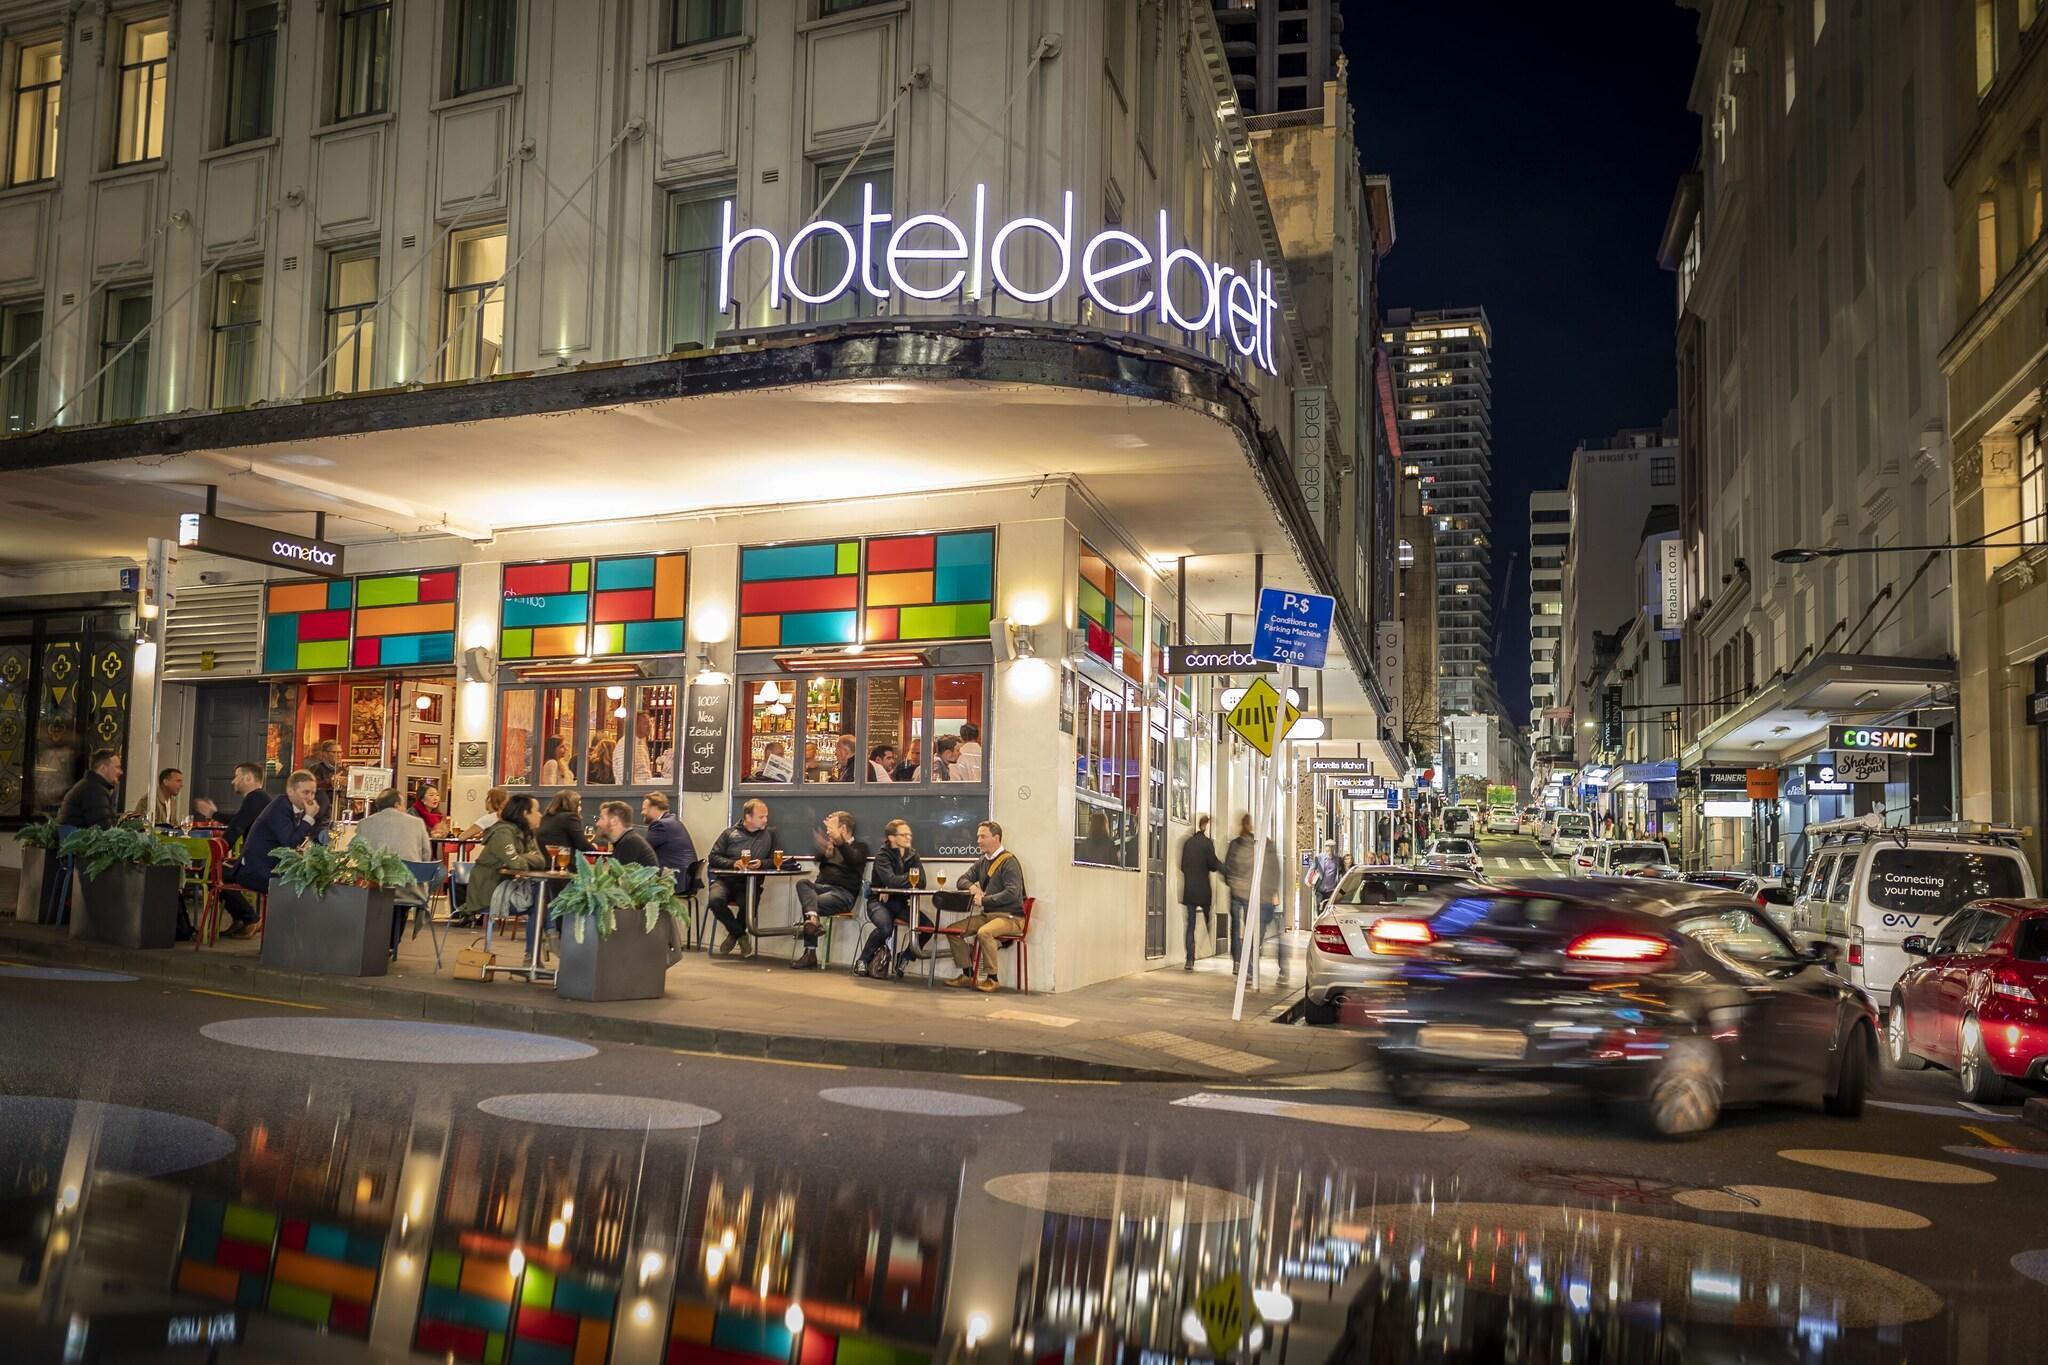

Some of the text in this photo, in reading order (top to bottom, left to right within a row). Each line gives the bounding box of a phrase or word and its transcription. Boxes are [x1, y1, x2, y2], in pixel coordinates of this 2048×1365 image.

[272, 541, 336, 566] cornerbar
[1667, 545, 1678, 619] brabant.co.nz
[1270, 615, 1307, 628] Conditions
[1263, 623, 1322, 639] Parking Machine
[1276, 637, 1307, 648] Times Vary
[1185, 650, 1257, 667] cornerba
[1273, 646, 1305, 661] Zone
[697, 695, 720, 707] 100%
[697, 711, 715, 723] New
[688, 726, 722, 737] Zealand
[1843, 730, 1919, 749] COSMIC
[691, 760, 715, 774] Beer
[1838, 753, 1884, 775] Shaka
[1855, 759, 1887, 780] Bowl
[1710, 773, 1747, 782] TRAINERS
[938, 842, 983, 856] cornerba
[1885, 873, 1945, 888] Connecting
[1884, 887, 1941, 898] your home
